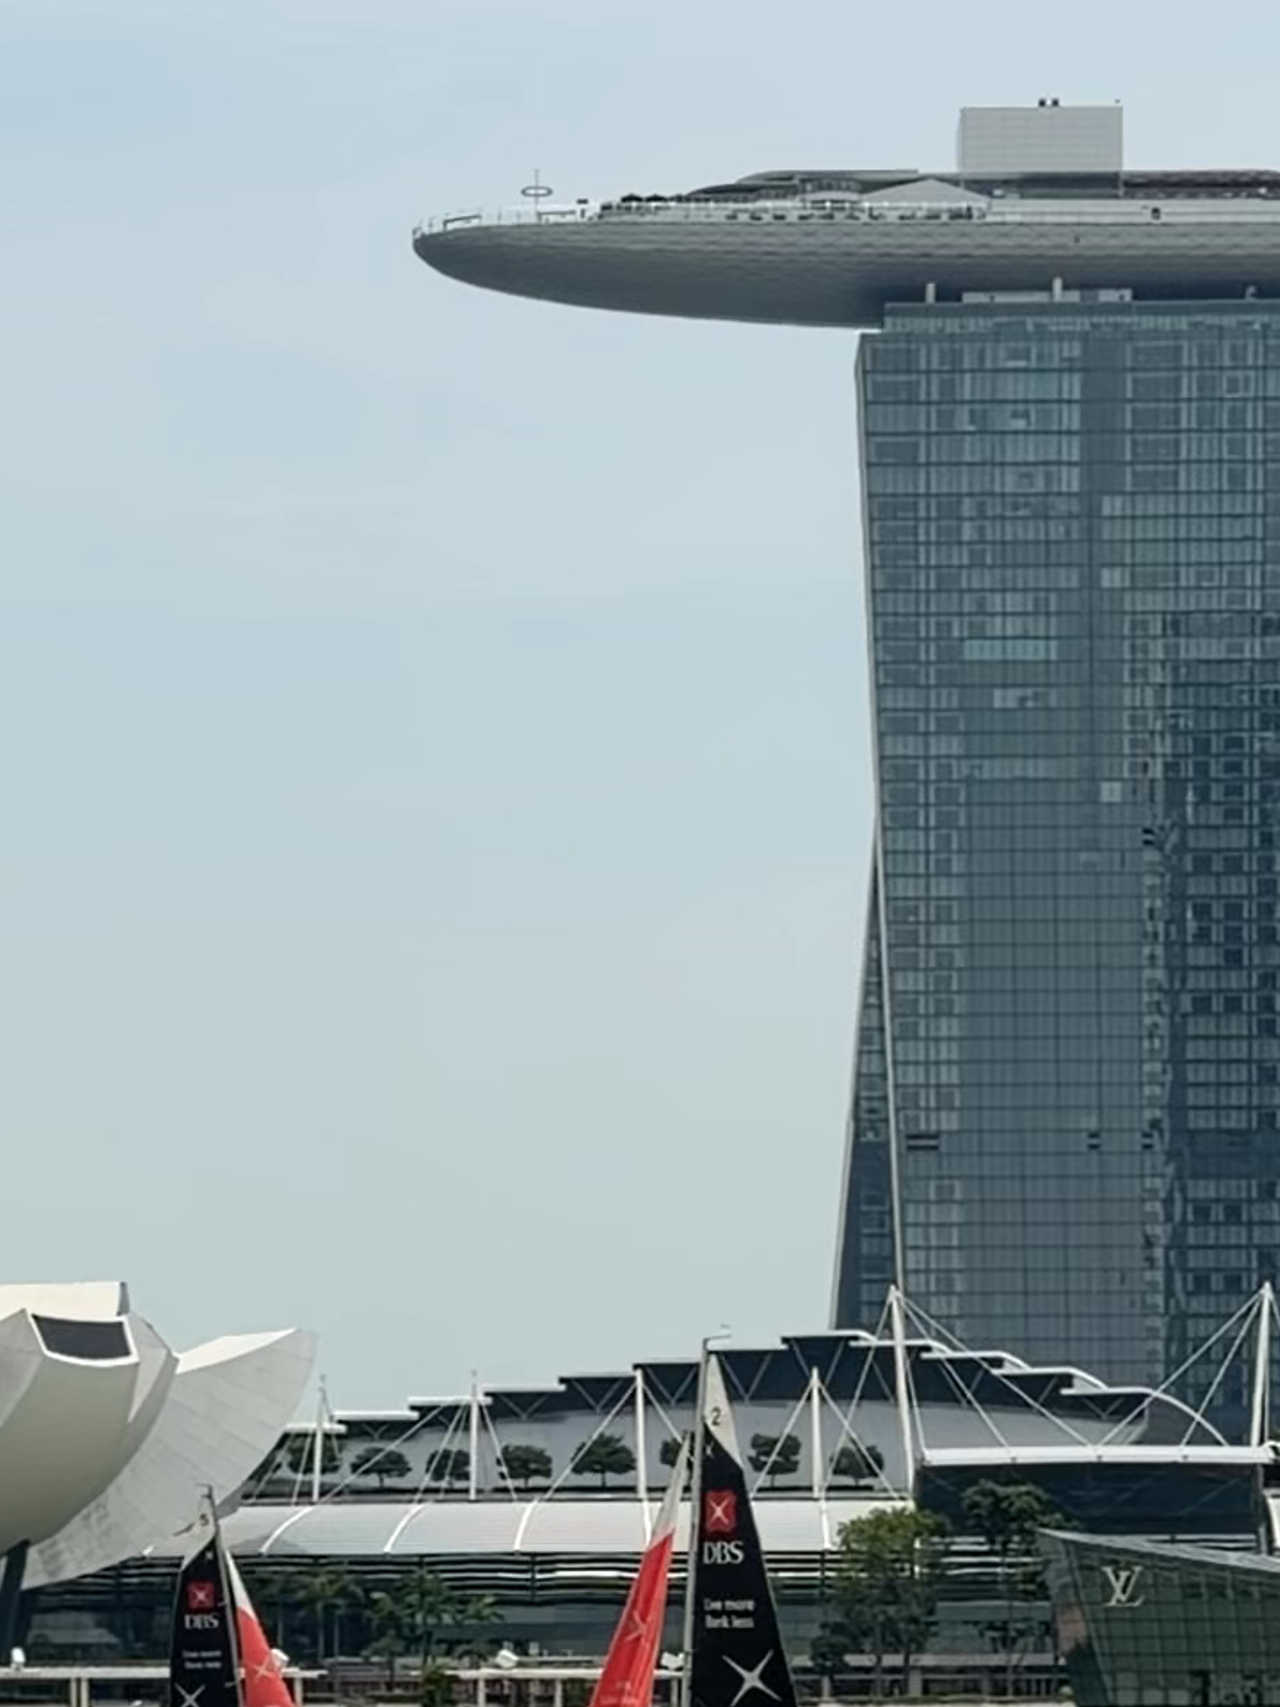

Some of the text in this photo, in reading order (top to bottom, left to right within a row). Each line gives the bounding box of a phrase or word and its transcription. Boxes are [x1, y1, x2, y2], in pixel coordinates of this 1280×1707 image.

[711, 1406, 721, 1426] 2
[703, 1540, 744, 1564] DBS
[184, 1614, 220, 1629] DBS
